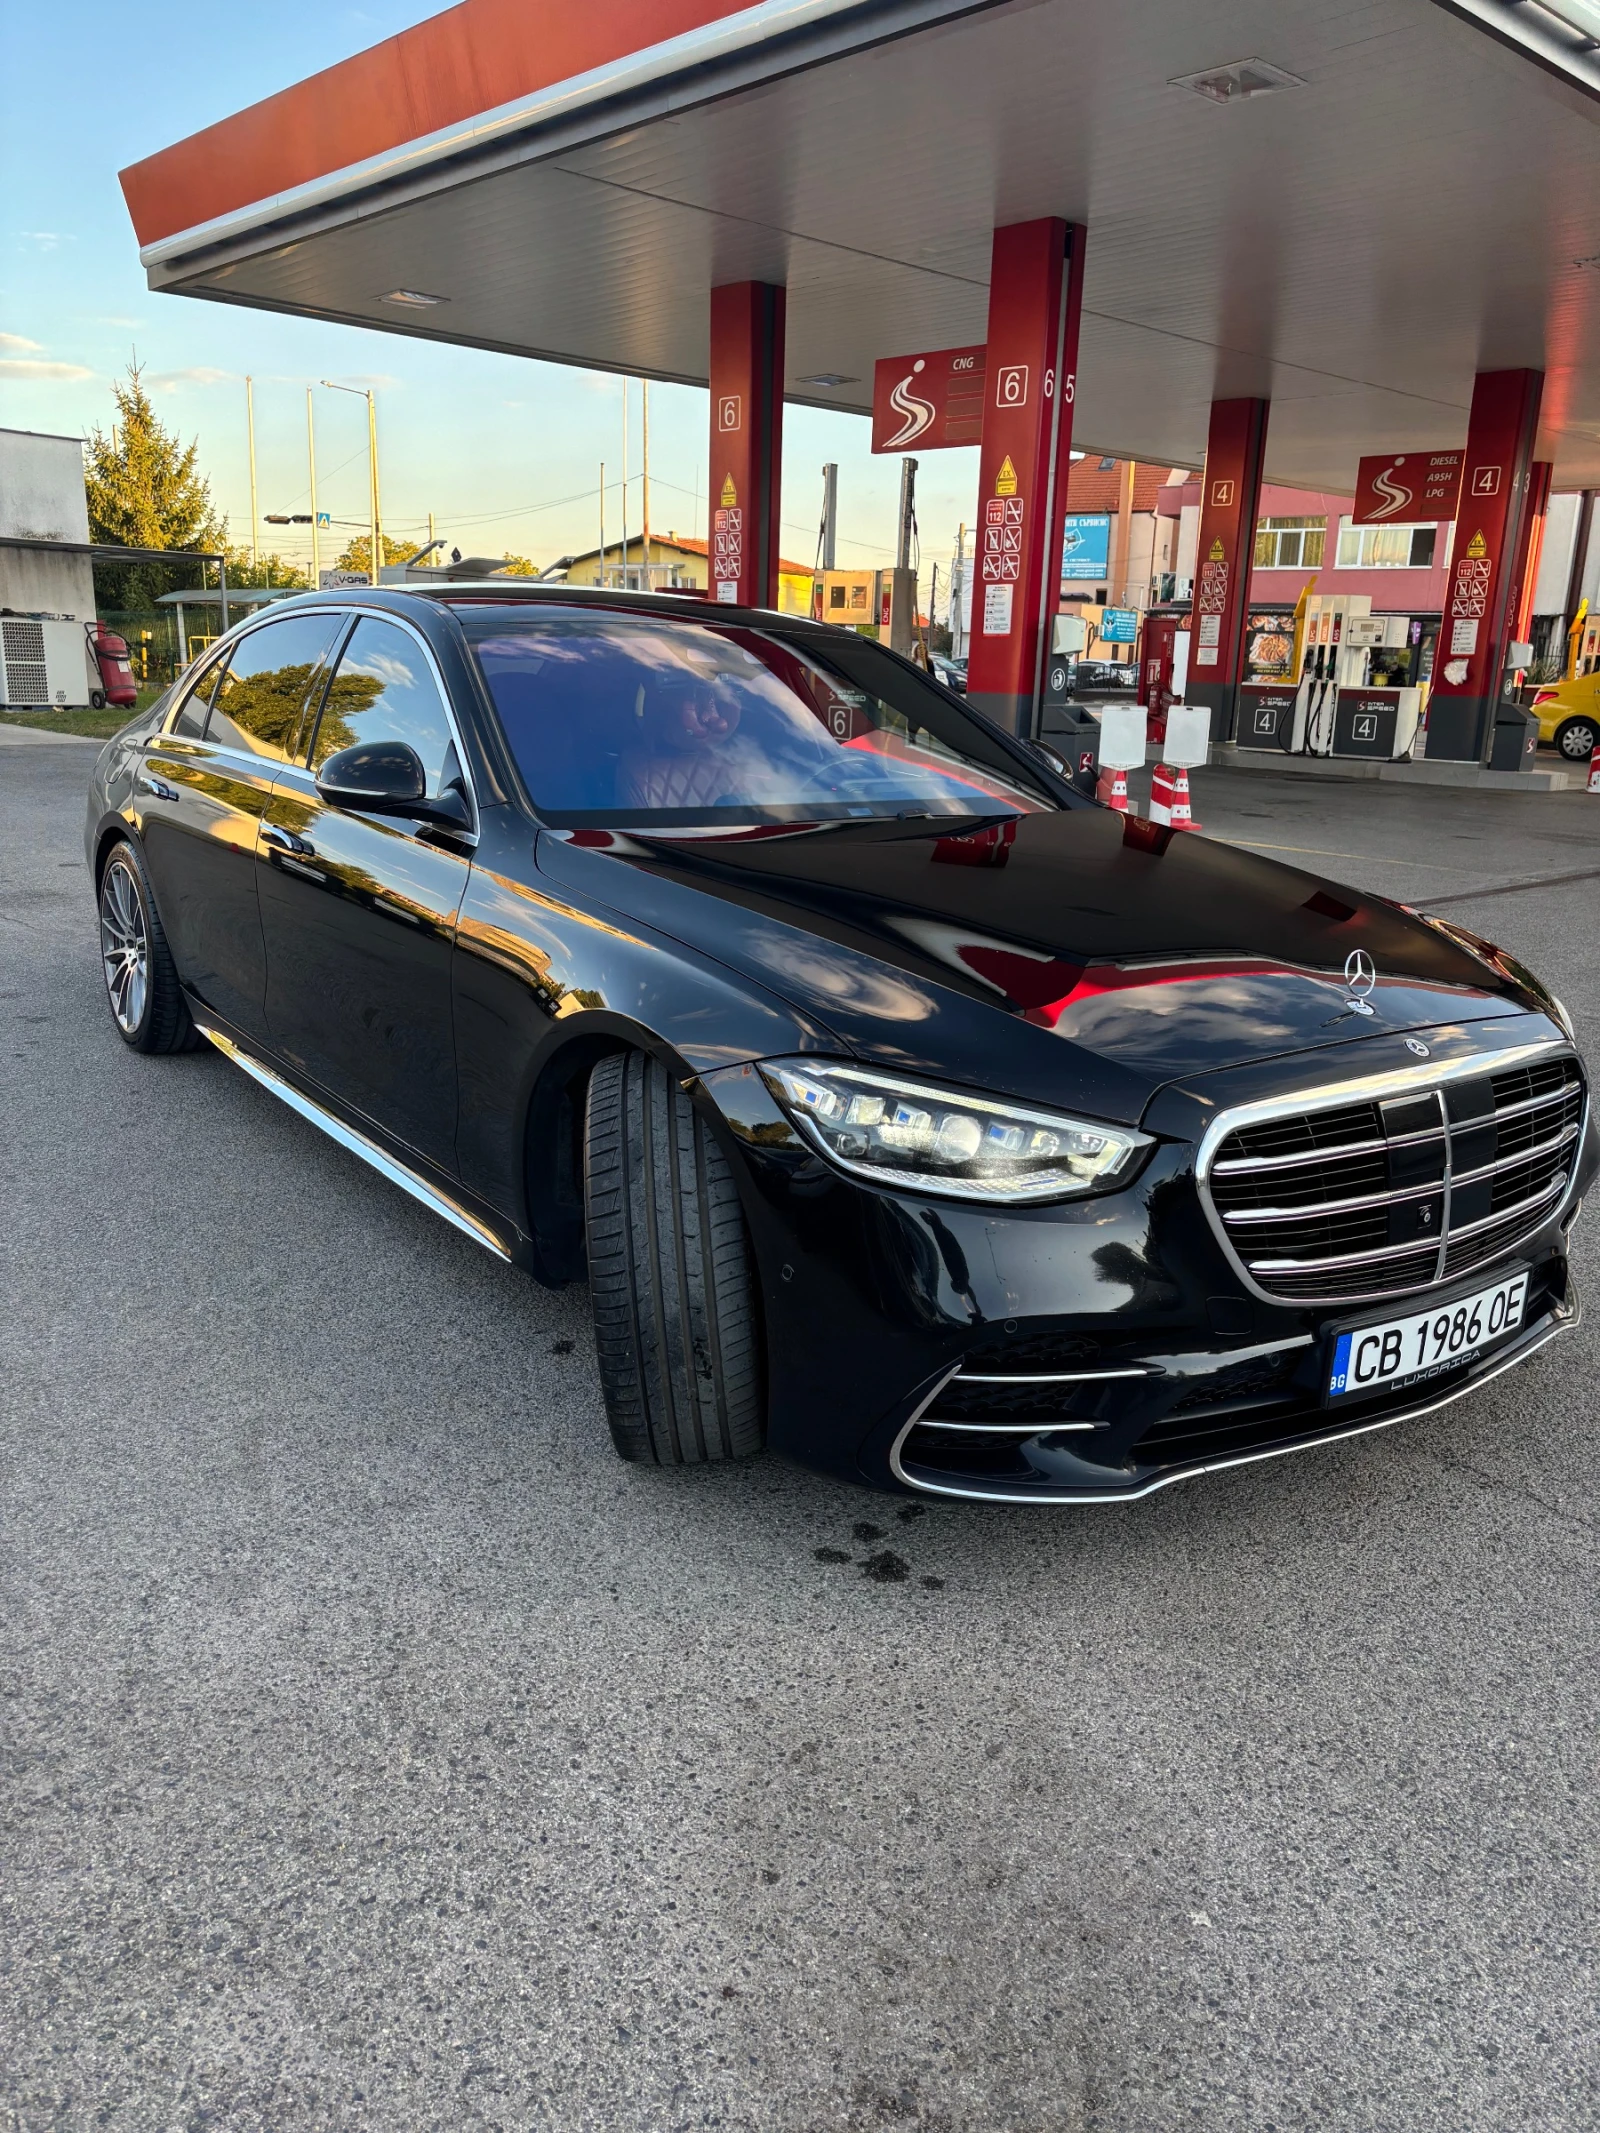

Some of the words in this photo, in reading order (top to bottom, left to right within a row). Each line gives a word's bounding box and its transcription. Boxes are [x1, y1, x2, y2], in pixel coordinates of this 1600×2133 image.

[953, 357, 975, 371] CNG
[1004, 371, 1020, 401] 6
[1044, 368, 1055, 398] 6
[1065, 374, 1075, 403] 5
[724, 401, 736, 427] 6
[1429, 456, 1459, 467] DIESEL
[1003, 470, 1011, 478] EX
[1426, 472, 1453, 483] A95H
[1478, 470, 1493, 492] 4
[1512, 471, 1521, 492] 4
[1523, 472, 1531, 493] 3
[1216, 483, 1228, 503] 4
[1425, 488, 1445, 498] LPG
[716, 520, 727, 529] 112
[989, 512, 1002, 522] 112
[338, 576, 368, 584] V-GAS
[1203, 569, 1214, 577] 112
[1460, 568, 1472, 577] 112
[882, 607, 890, 623] CNG
[834, 710, 847, 735] 6
[1259, 713, 1271, 731] 4
[1358, 718, 1371, 737] 4
[1354, 1328, 1403, 1383] CB
[1416, 1299, 1483, 1366] 1986
[1390, 1349, 1481, 1391] LUXORICA
[1330, 1374, 1346, 1391] BG
